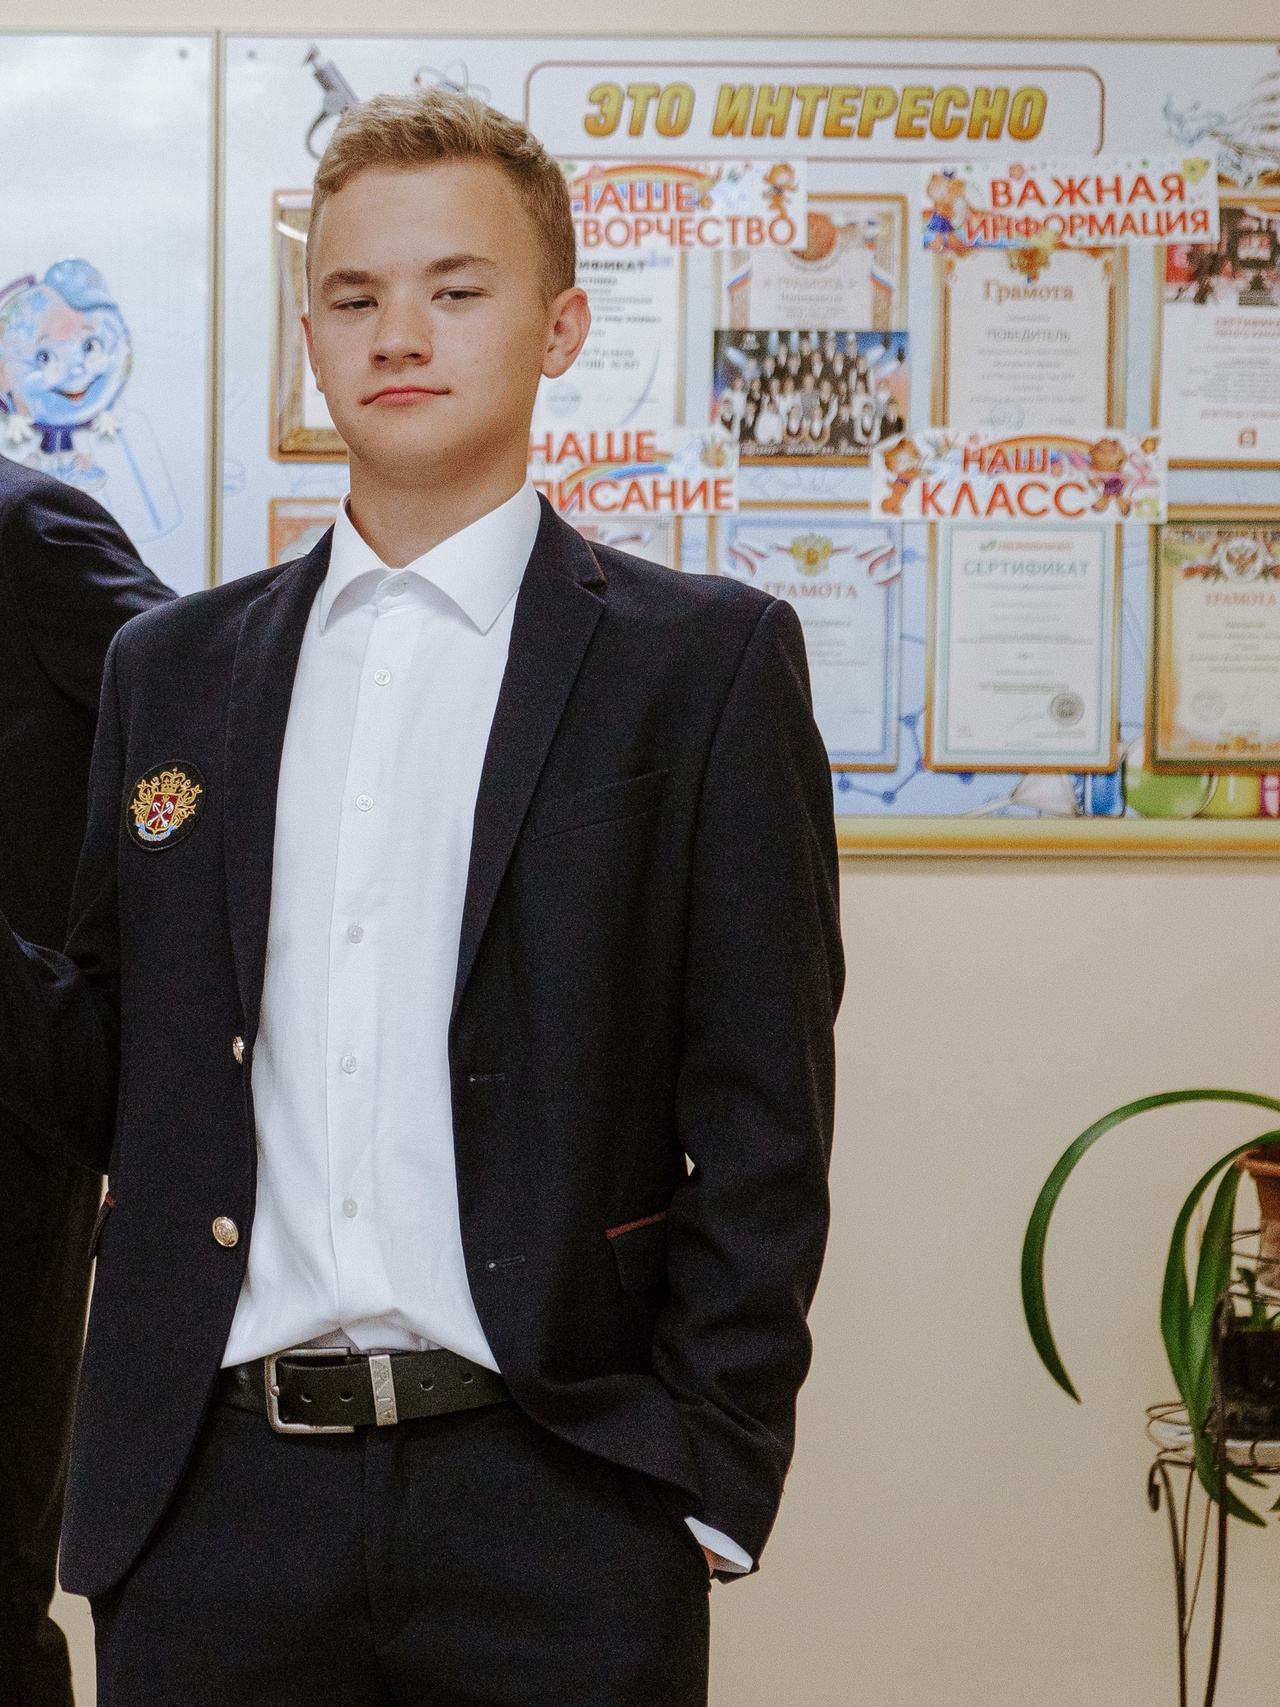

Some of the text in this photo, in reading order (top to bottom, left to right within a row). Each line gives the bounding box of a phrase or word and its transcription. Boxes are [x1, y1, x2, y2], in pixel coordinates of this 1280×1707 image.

[583, 82, 1049, 141] ЭТО ИНТЕРЕСНО
[991, 174, 1186, 208] ВАЖНАЯ
[573, 217, 796, 247] ВОРЧЕСТВО
[966, 208, 1210, 243] ИНФОРМАЦИЯ
[983, 279, 1075, 306] Грамота
[528, 430, 656, 465] НАШЕ
[962, 446, 1049, 474] НАШ
[920, 480, 1087, 518] КЛАСС
[963, 559, 1089, 577] СЕРТИФИКАТ
